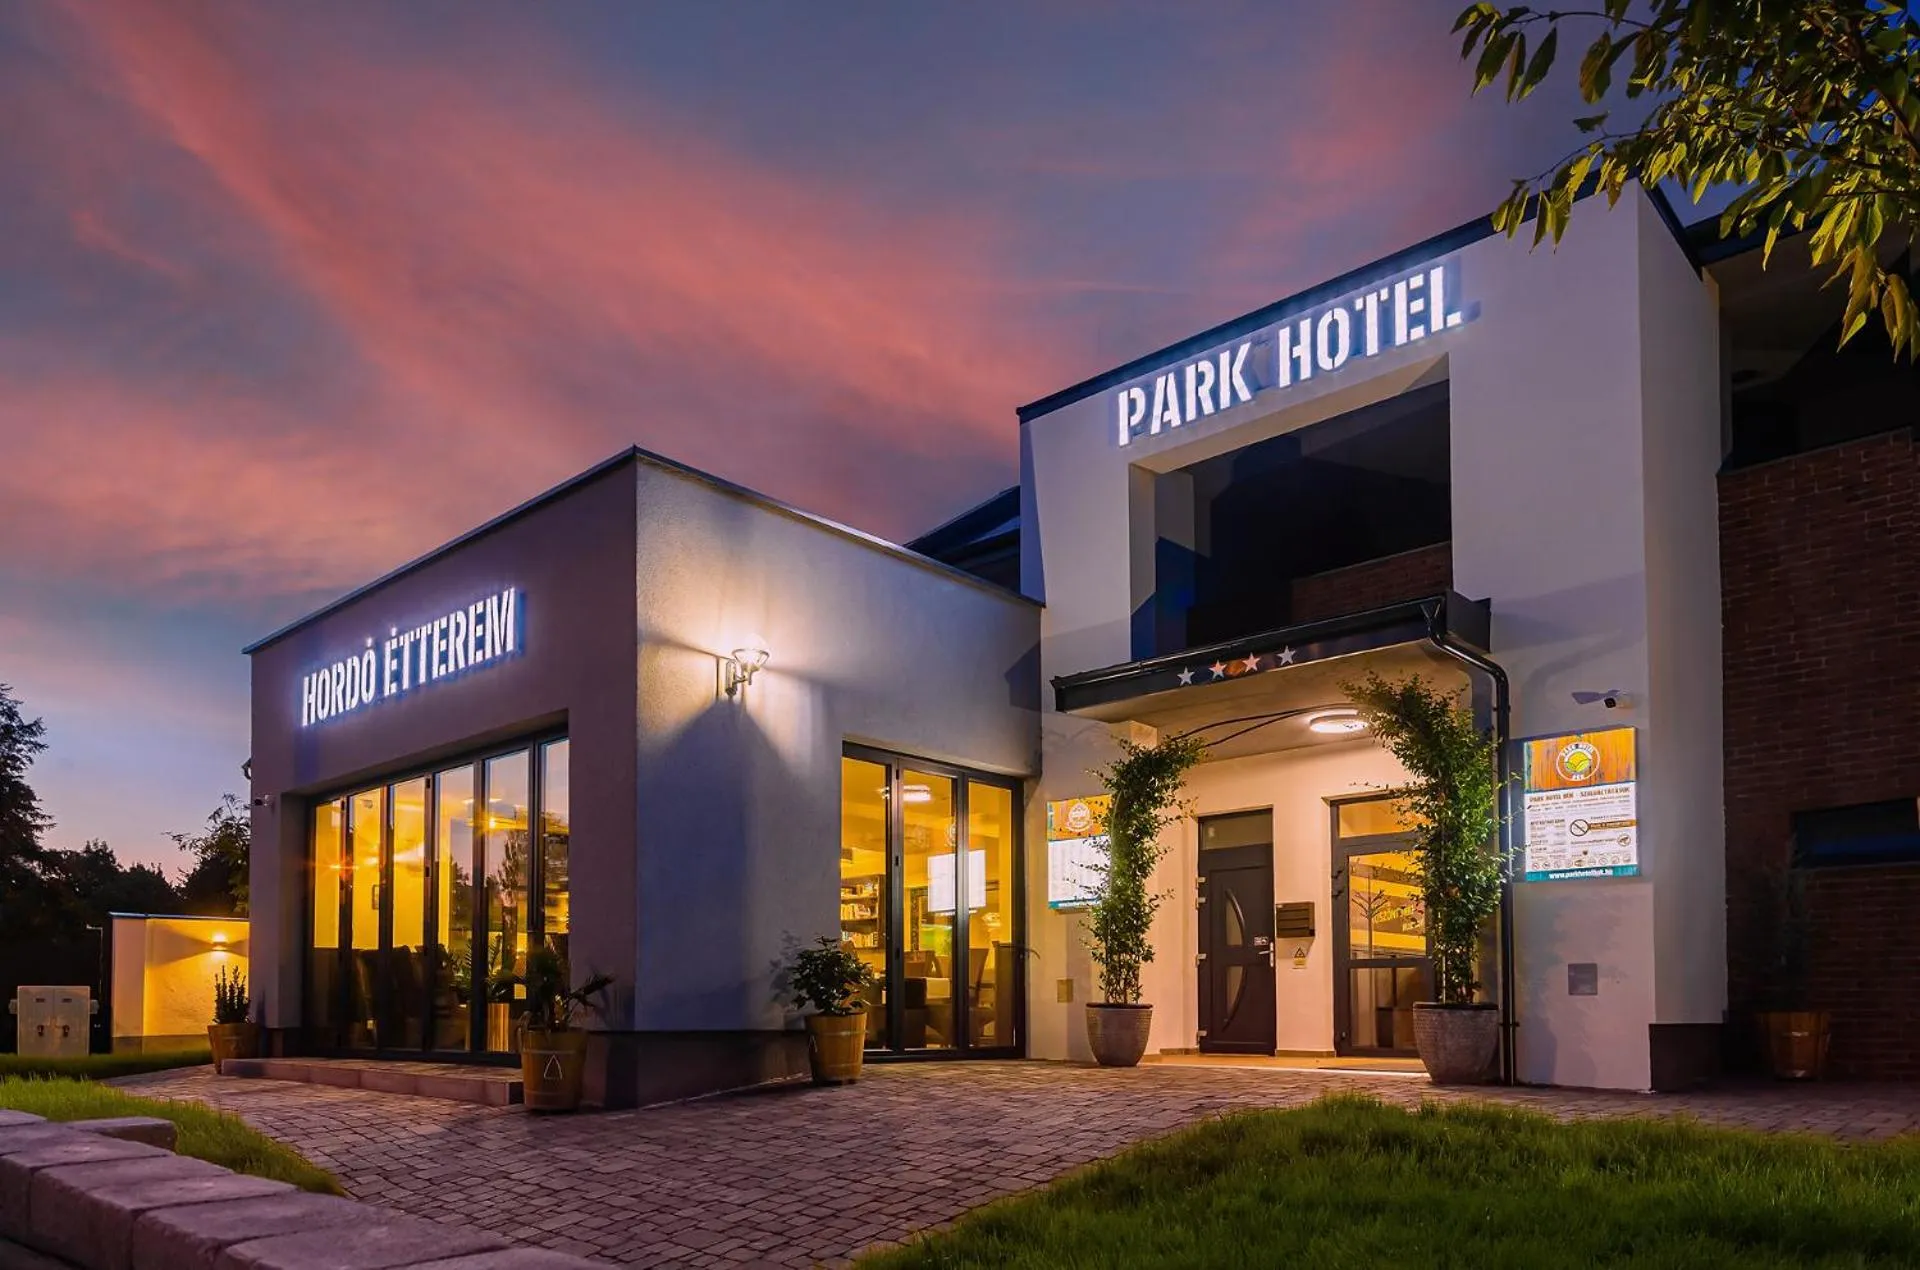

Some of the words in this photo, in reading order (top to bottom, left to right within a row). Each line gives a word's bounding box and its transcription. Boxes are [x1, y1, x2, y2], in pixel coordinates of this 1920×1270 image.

[1118, 342, 1252, 446] PARK
[1278, 266, 1462, 389] HOTEL
[302, 637, 376, 727] HORDÓ
[383, 587, 515, 697] ÉTTEREM
